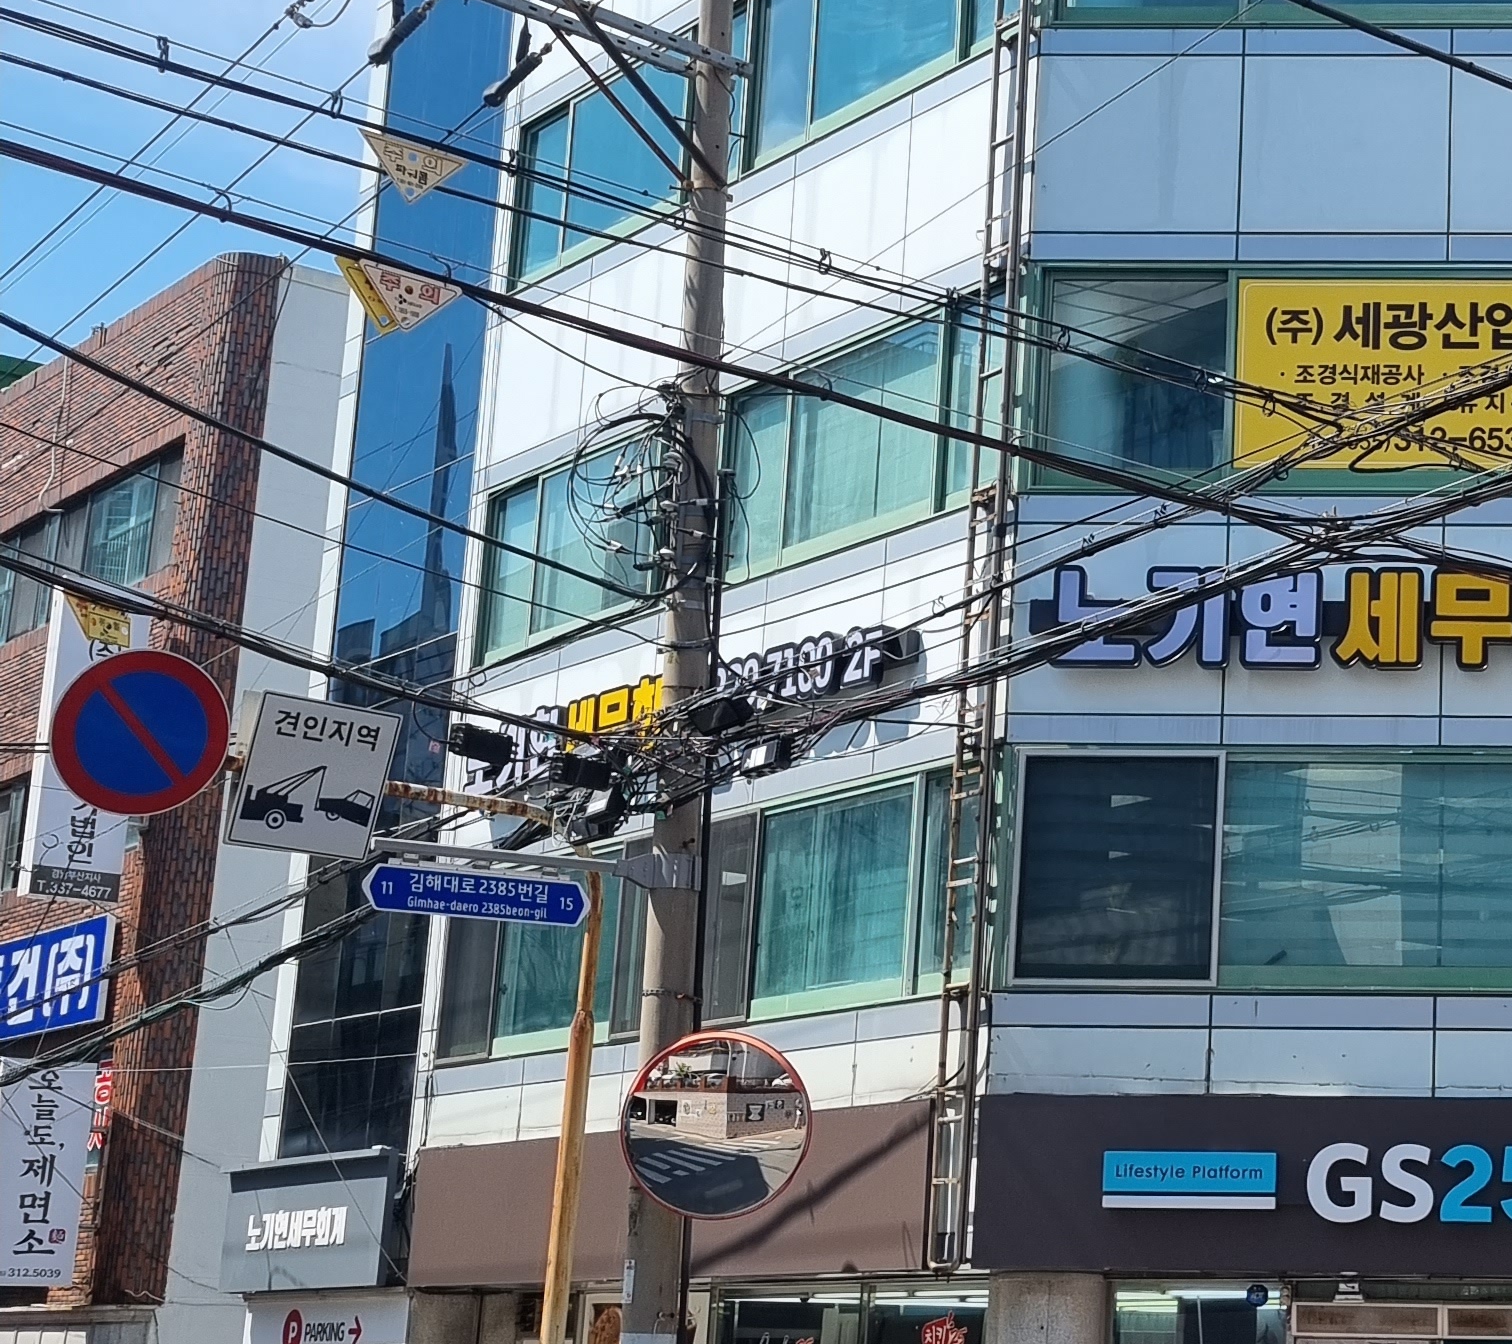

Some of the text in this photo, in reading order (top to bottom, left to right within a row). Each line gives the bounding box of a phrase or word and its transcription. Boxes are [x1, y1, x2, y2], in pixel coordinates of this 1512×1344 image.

[1265, 306, 1324, 346] (주)
[1294, 363, 1425, 386] 조경식재공사
[275, 709, 382, 752] 견인지역
[380, 880, 394, 895] 11
[408, 872, 549, 904] 김해대로2385번길
[407, 895, 548, 921] Gimhae-daero 2385beon-gil
[559, 896, 574, 911] 15
[0, 933, 95, 1027] 건(주)
[1115, 1163, 1263, 1183] Lifestyle Platform
[12, 1153, 57, 1257] 제면소
[245, 1205, 349, 1252] 노기현세무회계
[304, 1321, 346, 1343] PARKING
